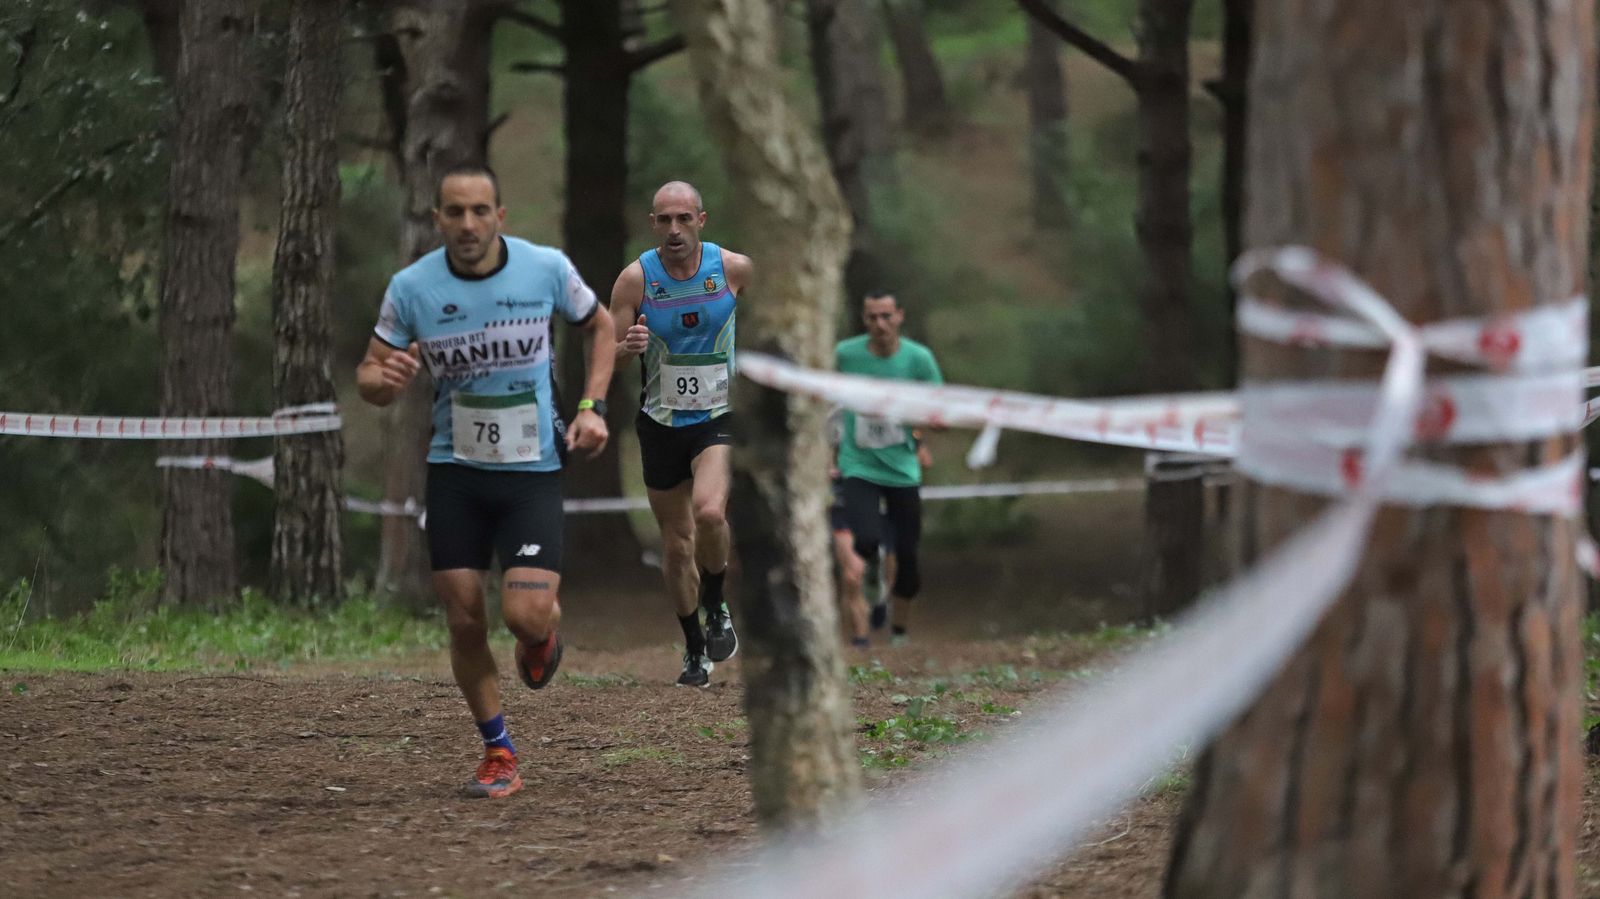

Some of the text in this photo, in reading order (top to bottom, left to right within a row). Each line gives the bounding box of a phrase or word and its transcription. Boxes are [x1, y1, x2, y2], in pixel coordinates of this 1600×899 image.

[430, 335, 467, 350] PRUEBA
[468, 331, 487, 344] BTT
[428, 336, 544, 368] MANILVA
[676, 376, 699, 395] 93
[473, 422, 500, 444] 78
